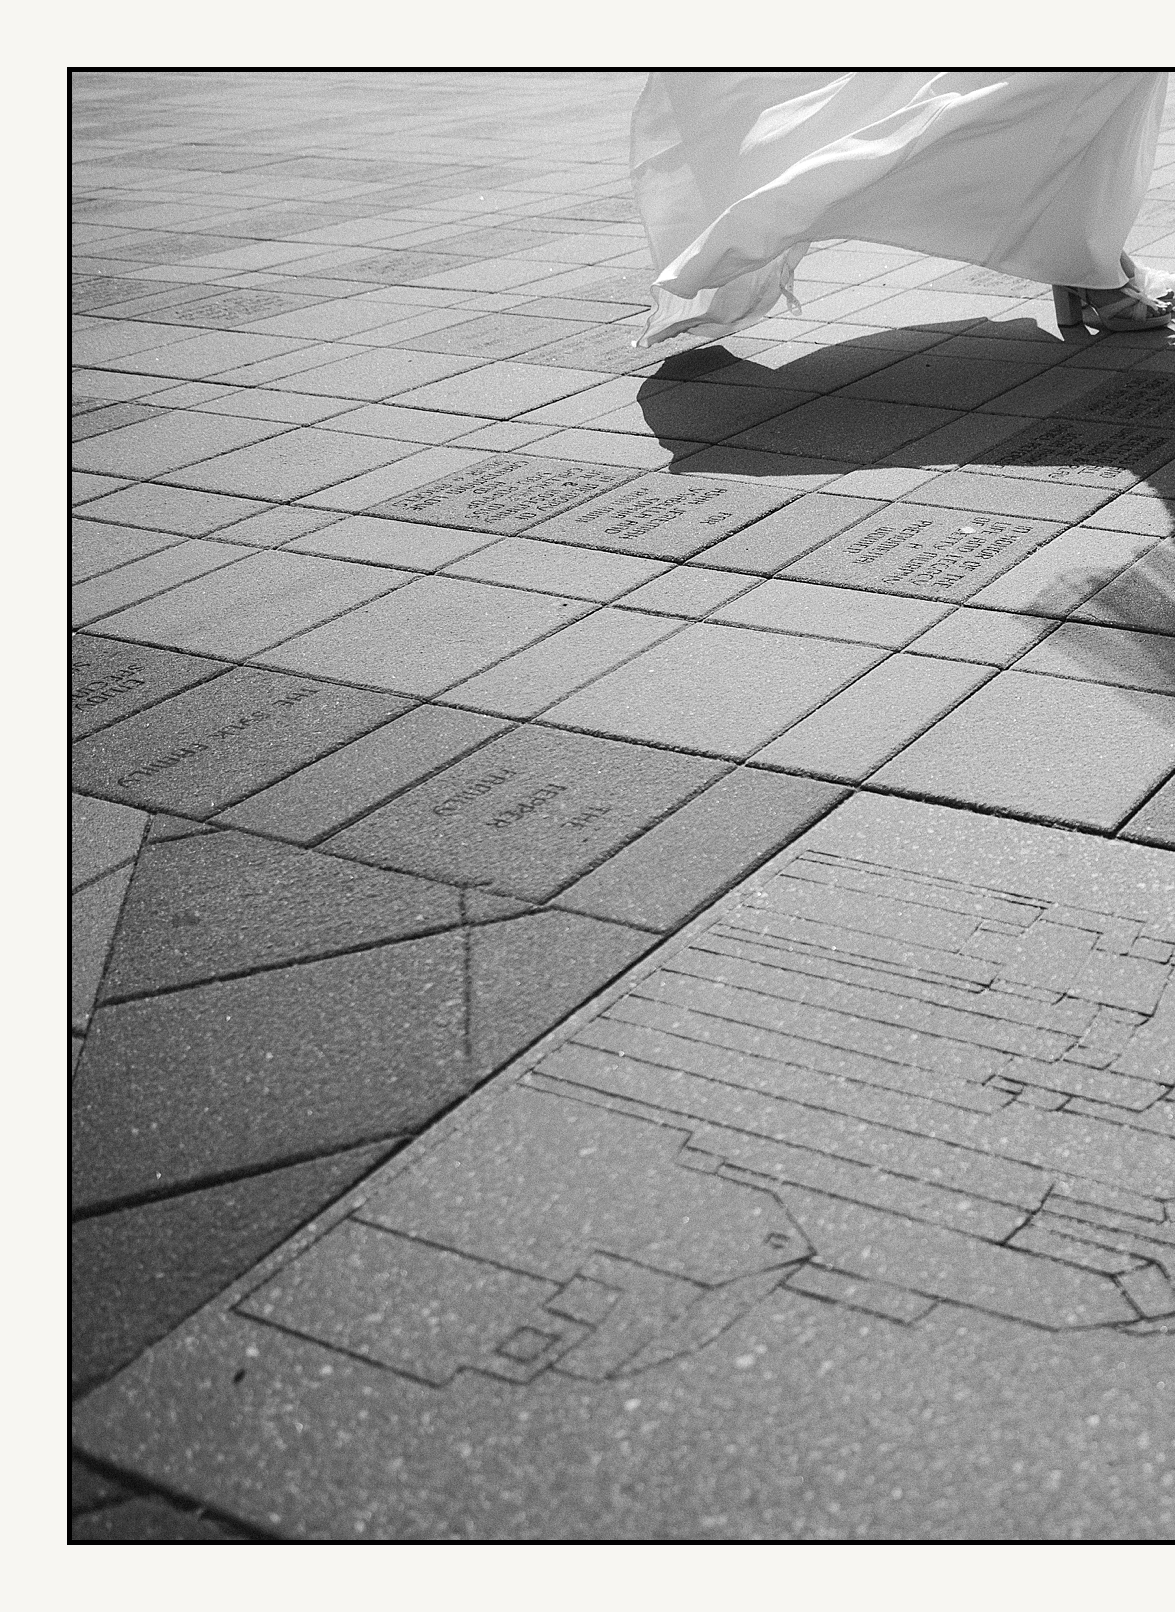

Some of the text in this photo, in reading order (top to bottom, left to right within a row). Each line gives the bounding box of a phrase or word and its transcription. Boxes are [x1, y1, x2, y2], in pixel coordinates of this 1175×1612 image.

[599, 519, 641, 535] AND
[697, 511, 734, 525] FOR
[874, 516, 994, 585] OF ETTY MURPHY
[902, 521, 1014, 586] LIFE AND LEGACY
[928, 525, 1036, 588] IN HONOR OF THE
[108, 686, 321, 788] THE SYLK FAMILY
[425, 767, 522, 818] FAMILY
[558, 803, 613, 831] THE
